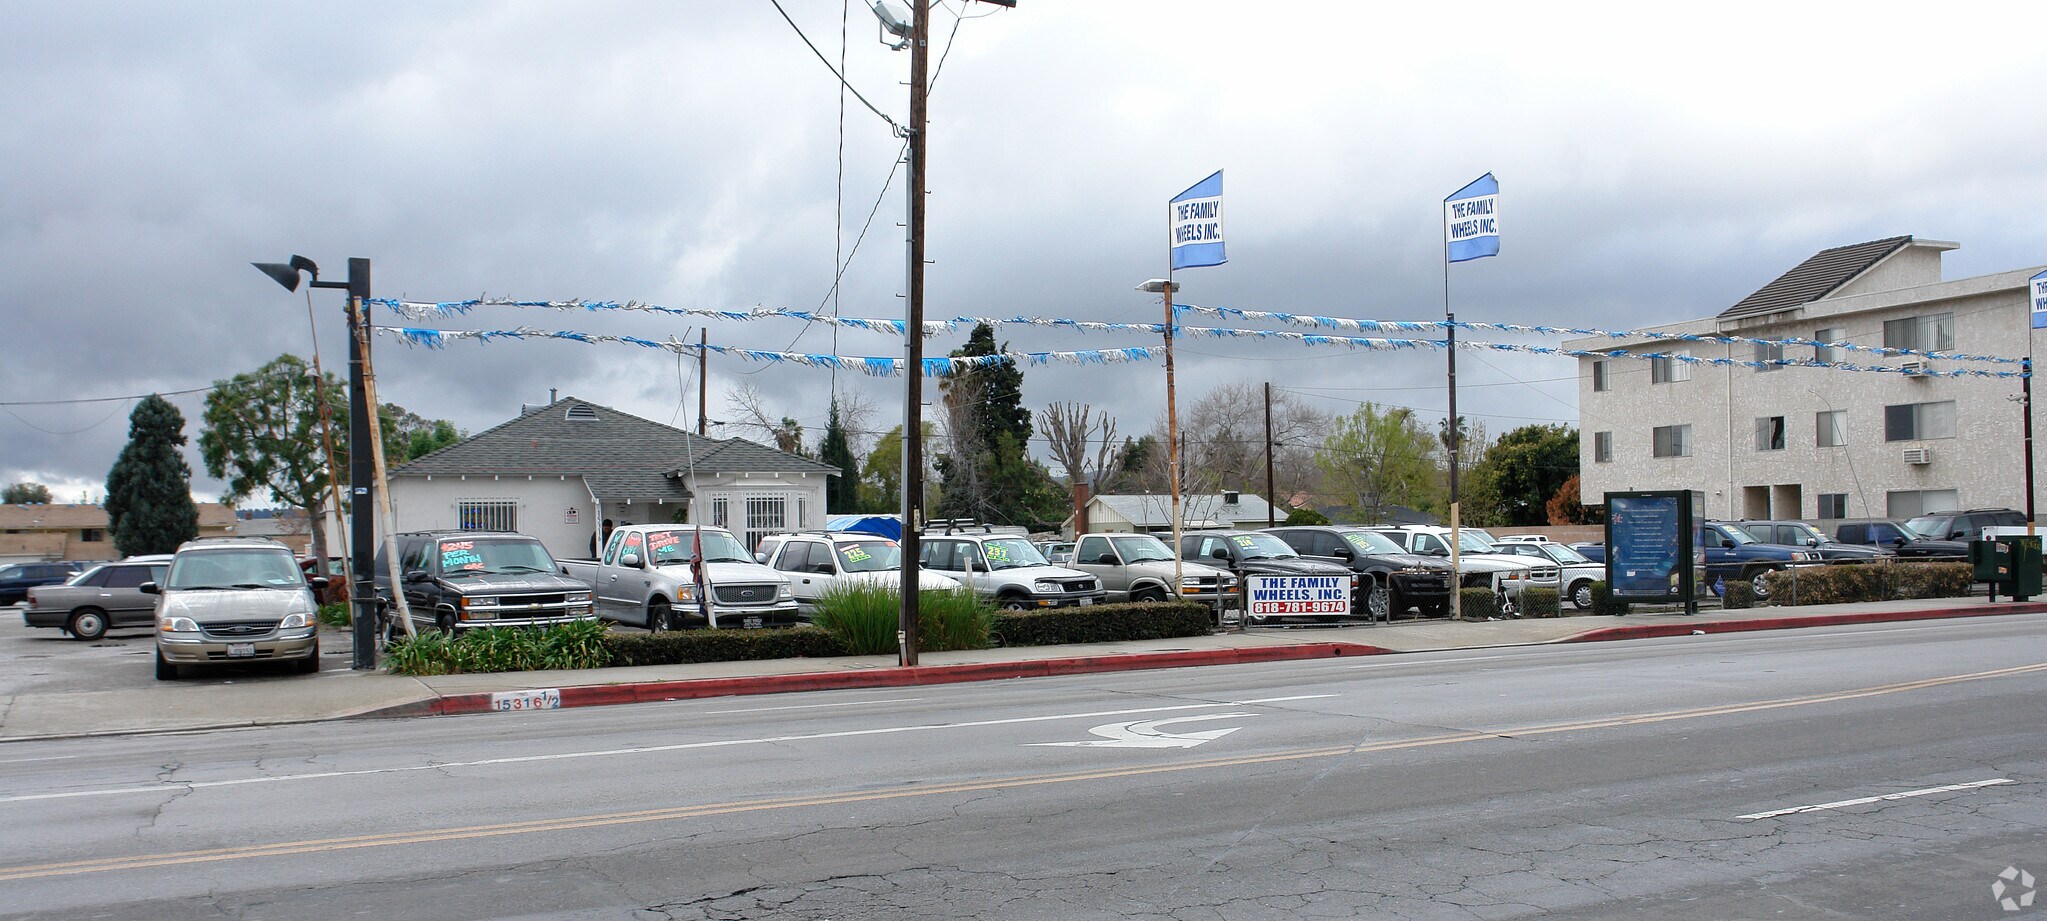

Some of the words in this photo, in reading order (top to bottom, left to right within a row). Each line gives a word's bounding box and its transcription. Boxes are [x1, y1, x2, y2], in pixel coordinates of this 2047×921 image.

[1177, 203, 1189, 222] THE
[1189, 201, 1219, 219] FAMILY
[1451, 203, 1465, 219] THE
[1466, 198, 1493, 216] FAMILY
[1175, 224, 1202, 244] WHEELS
[1203, 222, 1220, 240] INC.
[1451, 219, 1478, 239] WHEELS
[1479, 218, 1497, 233] INC.
[648, 536, 680, 550] DRIVE
[442, 550, 469, 559] PER
[843, 547, 865, 559] 225
[442, 554, 481, 567] MONTH
[1260, 577, 1287, 589] THE
[1290, 577, 1340, 589] FAMILY
[1253, 589, 1314, 601] WHEELS,
[1317, 588, 1347, 600] INC.
[1254, 602, 1345, 613] 818-781-9674
